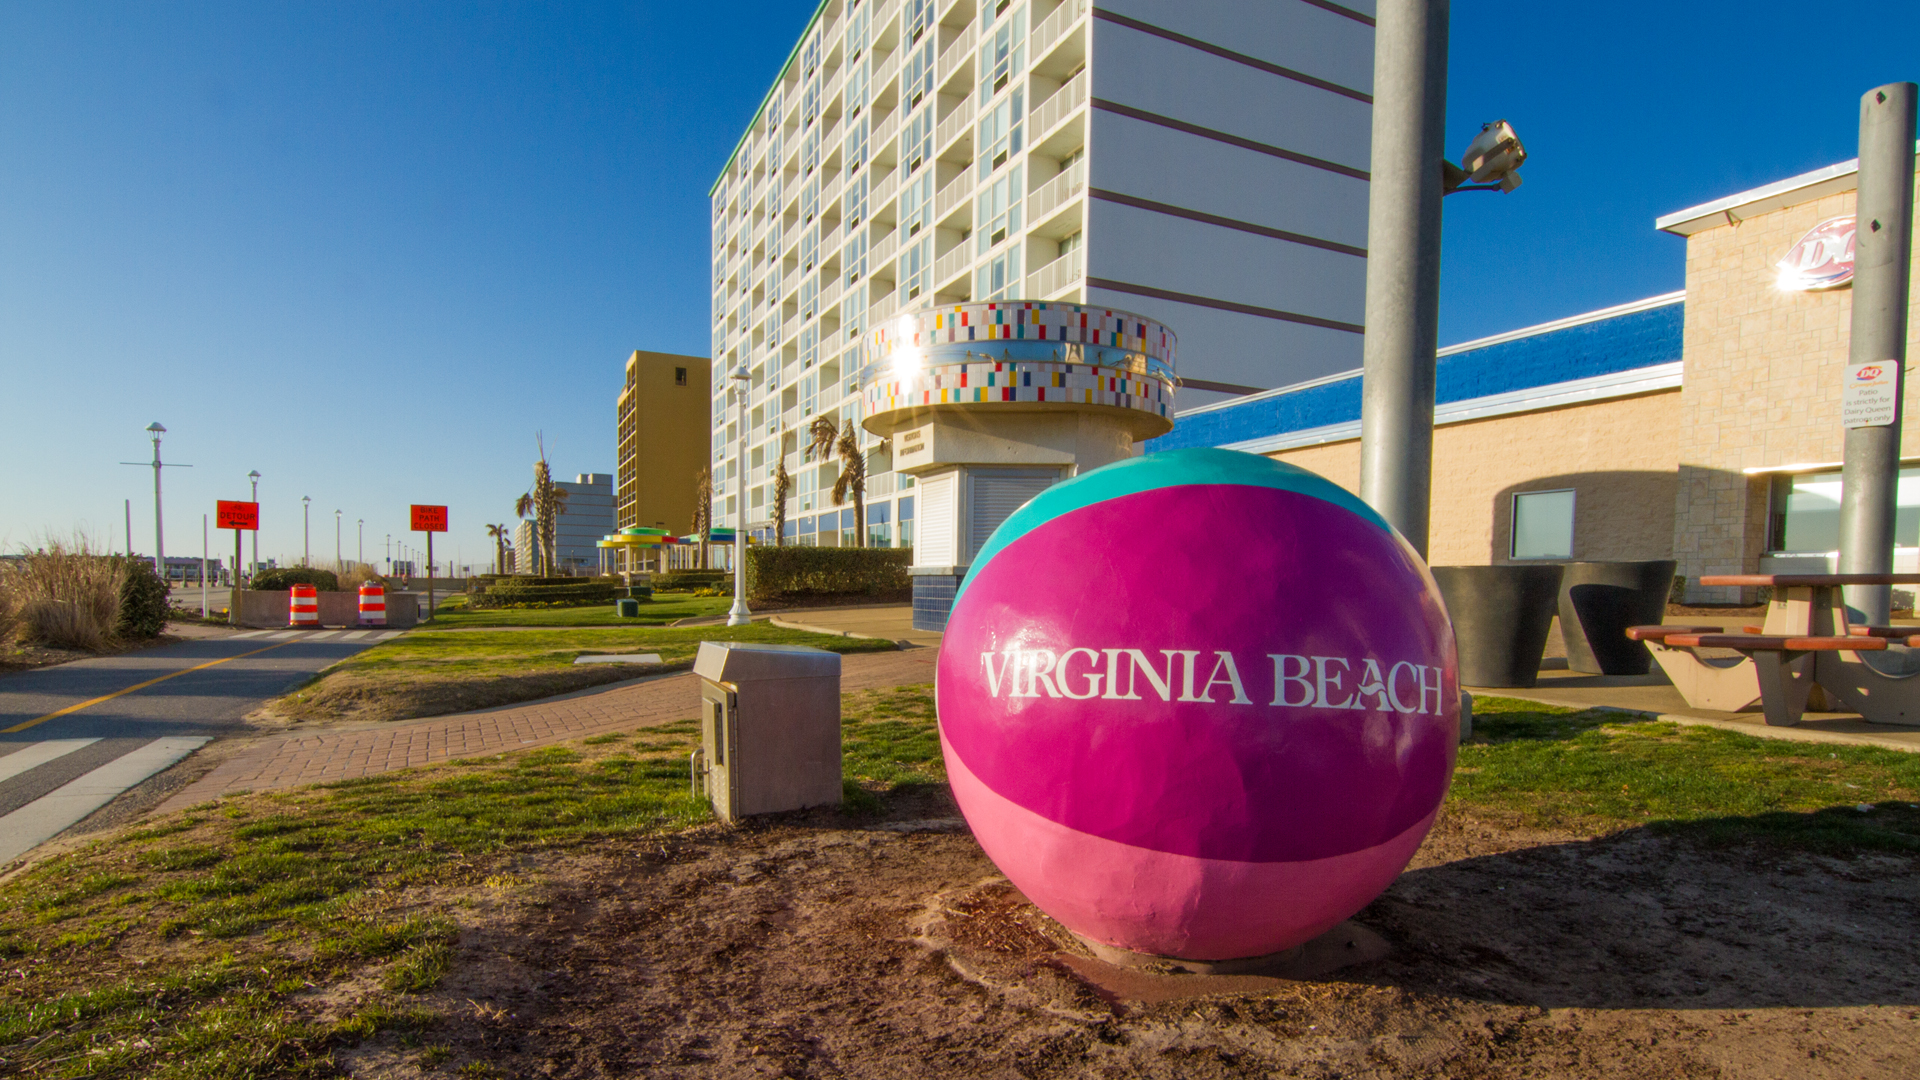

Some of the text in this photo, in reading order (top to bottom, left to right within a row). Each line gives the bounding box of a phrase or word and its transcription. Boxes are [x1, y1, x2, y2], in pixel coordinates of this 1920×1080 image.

[1859, 367, 1882, 379] DQ
[1853, 397, 1878, 405] strictly
[1843, 414, 1891, 425] patrons only
[420, 506, 438, 514] BIKE
[220, 511, 256, 520] DETOUR
[419, 514, 440, 522] PATH
[413, 522, 445, 530] CLOSED
[981, 647, 1443, 716] VIRGINIA BEACH
